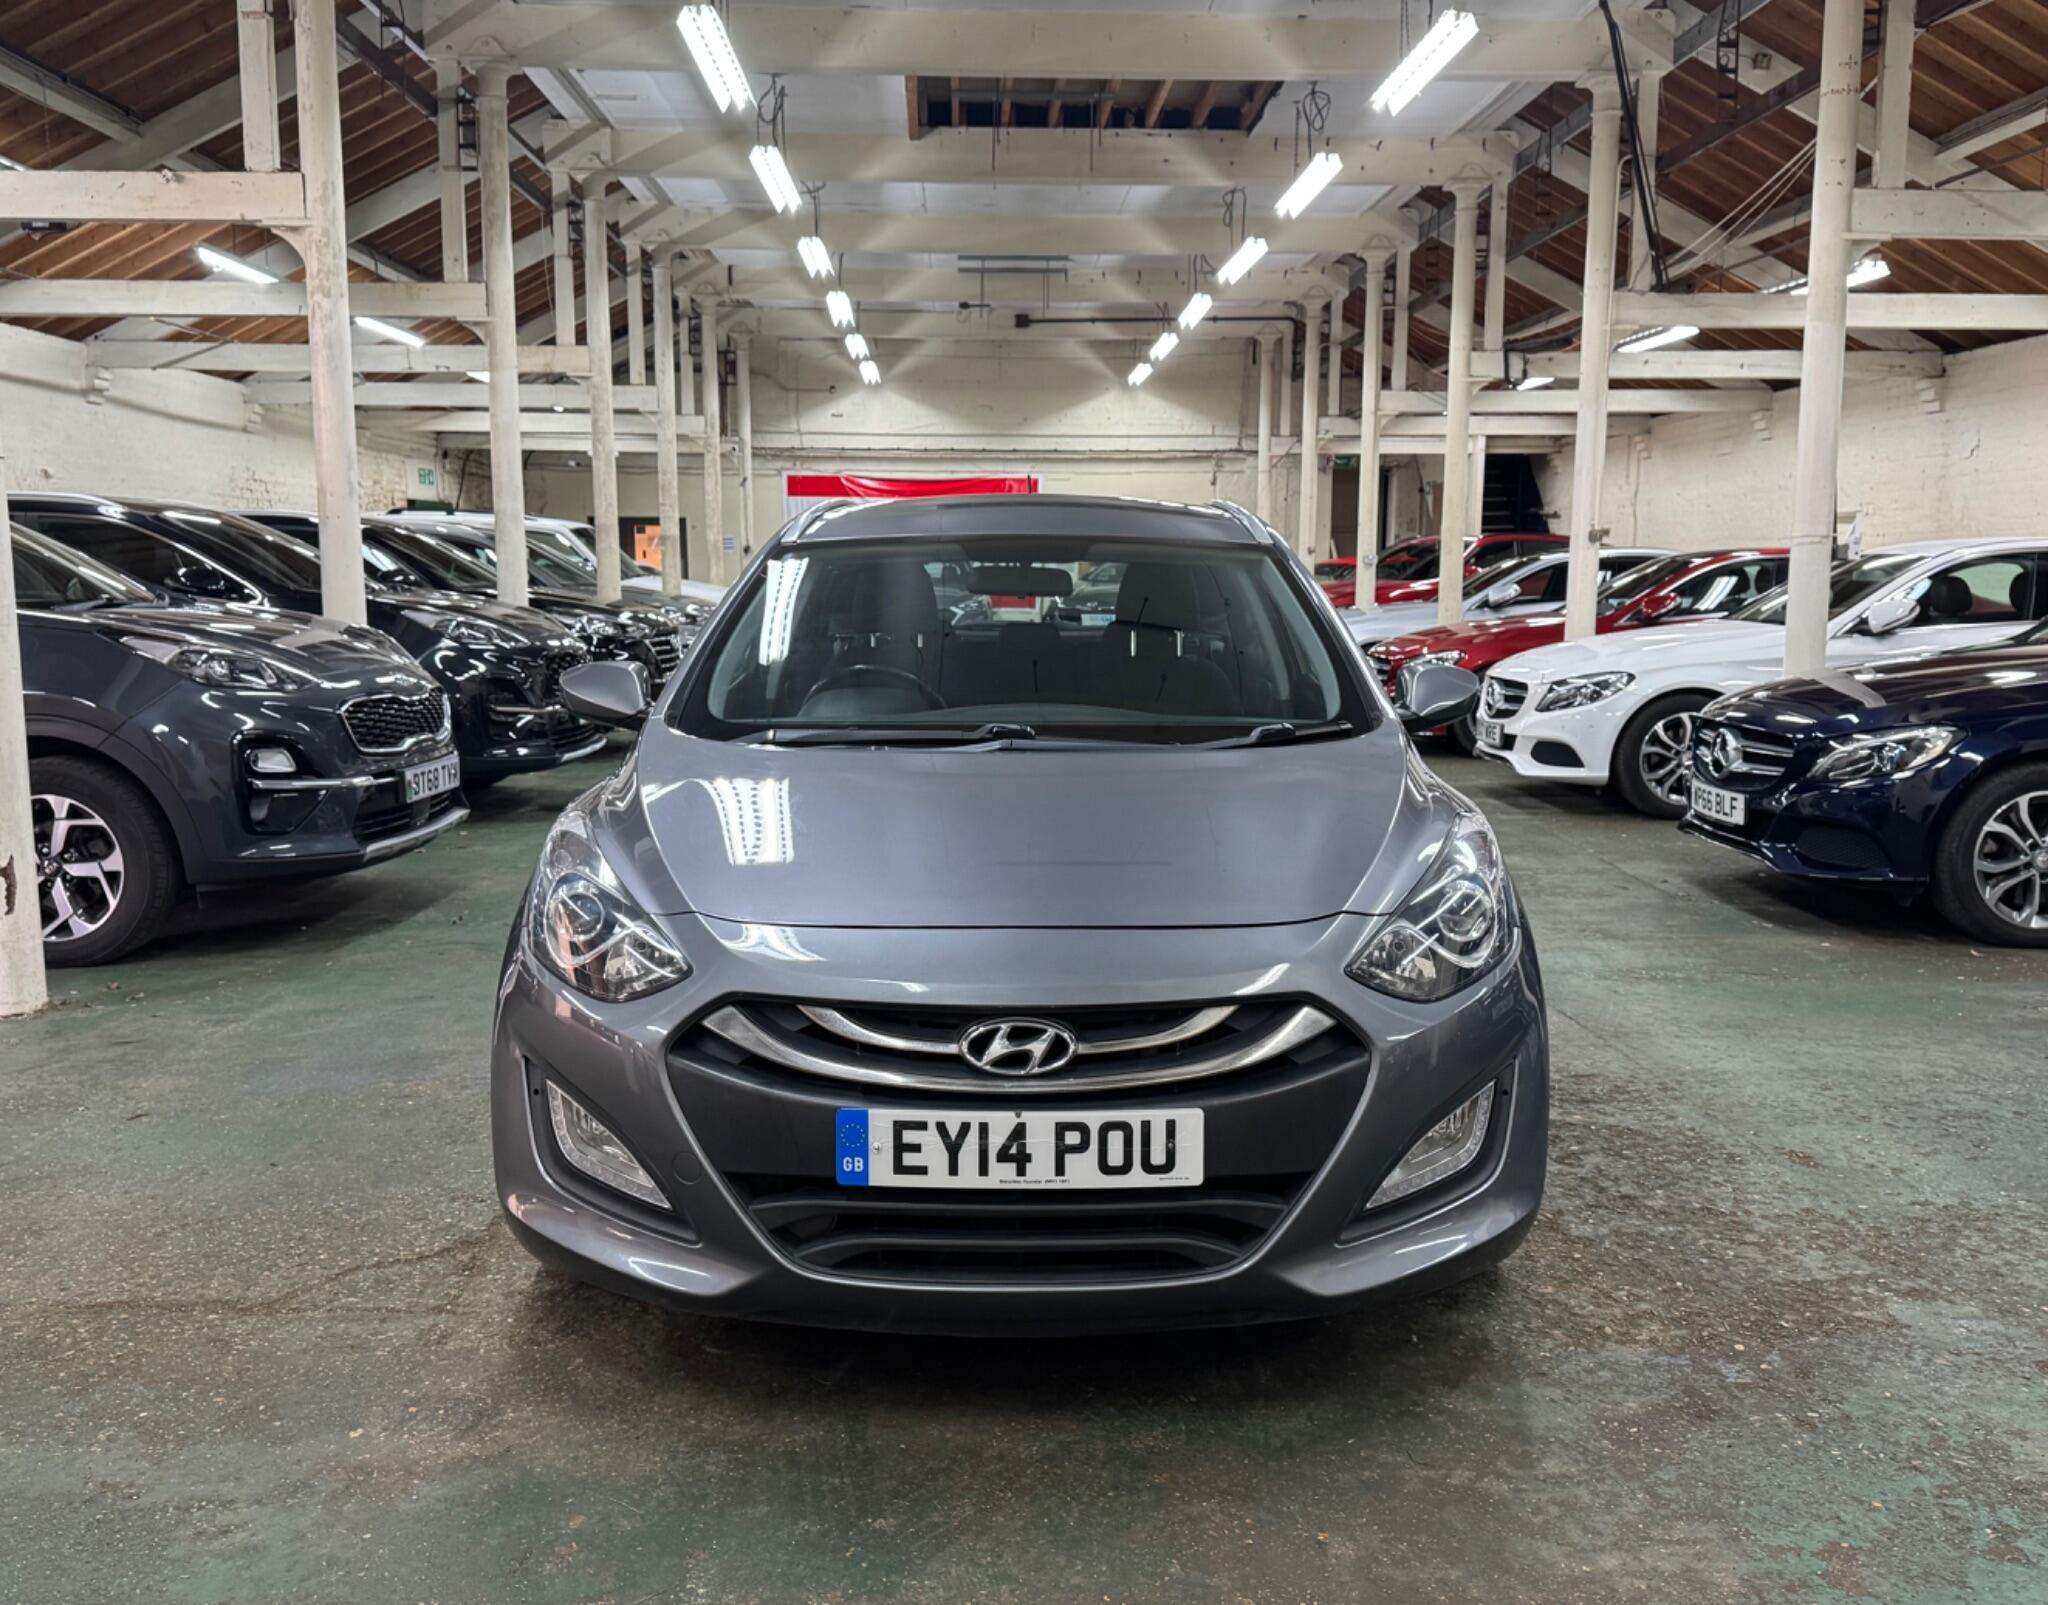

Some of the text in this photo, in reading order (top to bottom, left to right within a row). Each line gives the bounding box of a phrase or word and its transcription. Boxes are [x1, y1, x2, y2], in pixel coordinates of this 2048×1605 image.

[413, 770, 439, 796] ST68
[1715, 792, 1738, 818] BLF
[892, 1119, 1177, 1177] EY14 POU
[843, 1157, 864, 1172] GB
